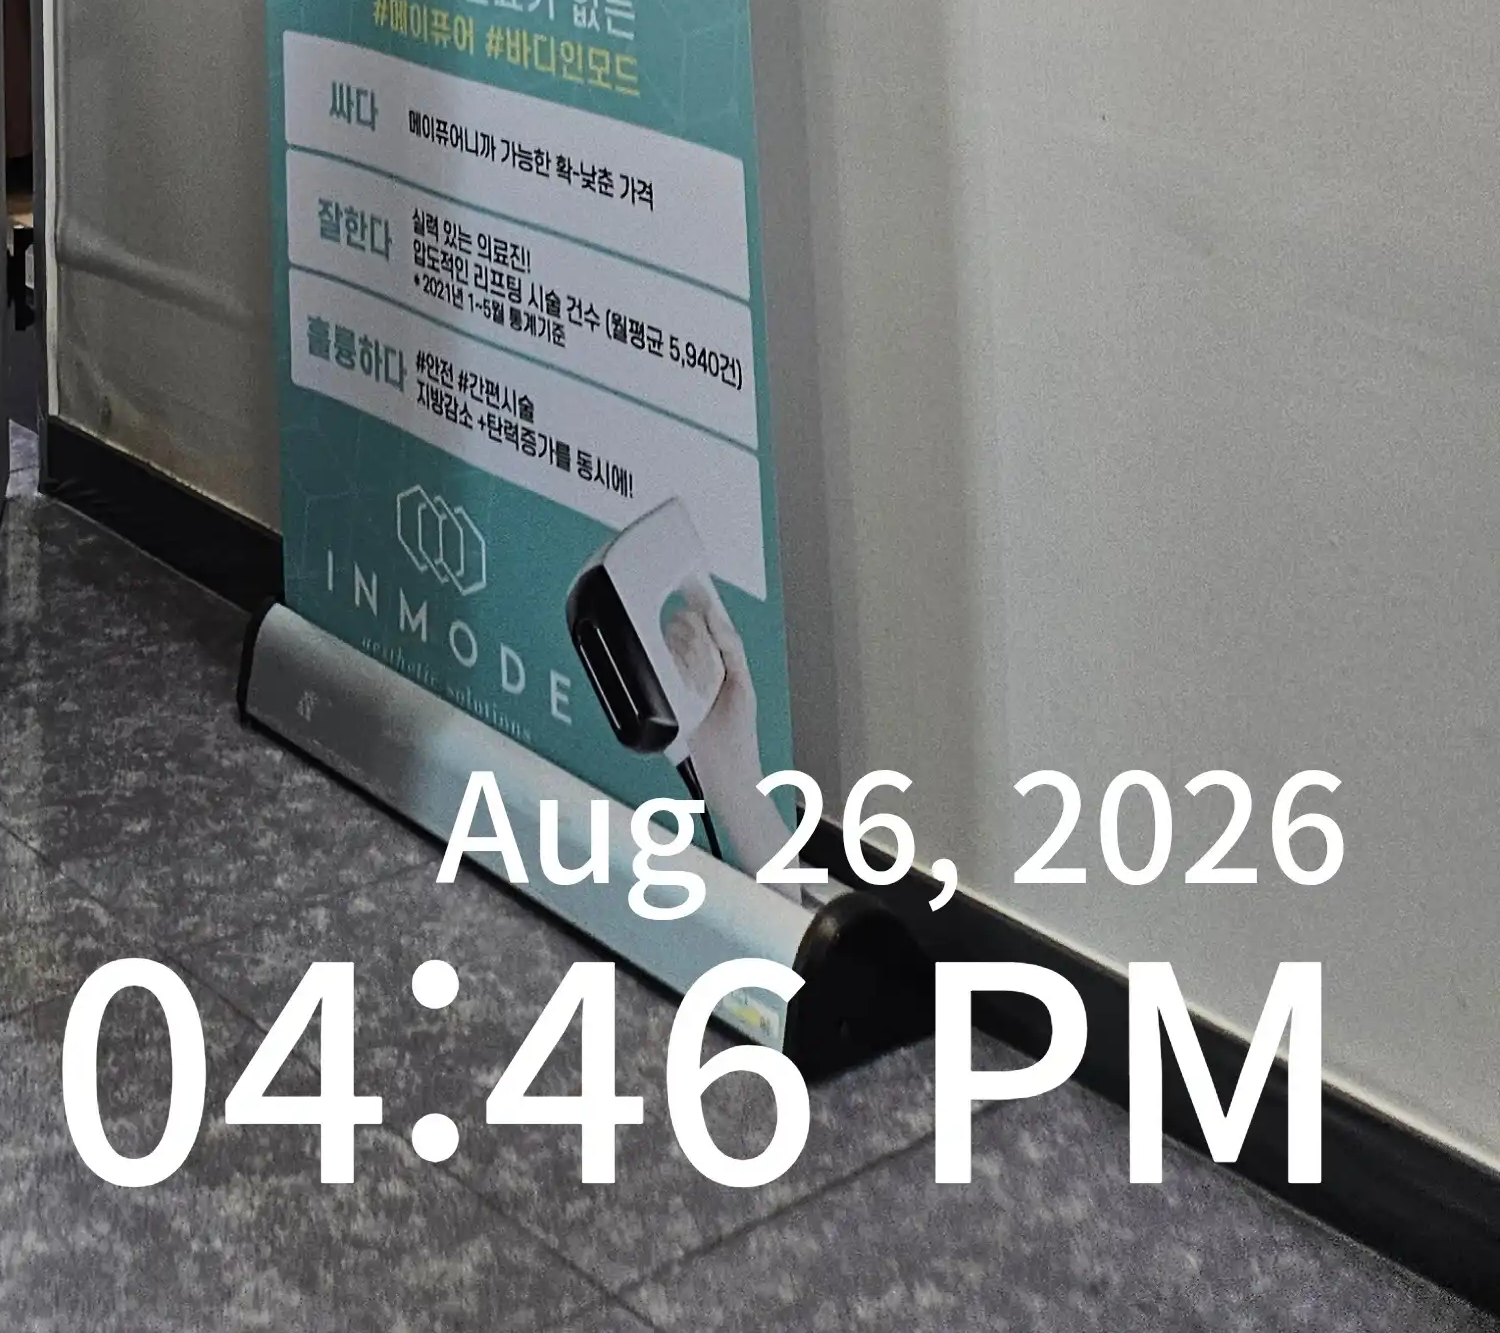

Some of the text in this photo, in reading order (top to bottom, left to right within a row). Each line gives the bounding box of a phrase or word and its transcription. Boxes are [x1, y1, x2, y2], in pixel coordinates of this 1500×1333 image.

[485, 24, 641, 99] #바디인모드
[329, 80, 379, 133] 싸다
[407, 109, 656, 213] 메이퓨어니까 가능한 확-낮춘 가격
[317, 196, 393, 263] 잘한다
[411, 206, 532, 276] 실력 있는 의료진!
[306, 312, 409, 393] 훌륭하다
[412, 238, 744, 393] 압도적인 리프팅 시술 건수 (월평균 5,940건)
[467, 289, 506, 328] 1~5월
[508, 306, 567, 349] 통계기준
[415, 349, 536, 425] #안전 #간편시술
[416, 379, 635, 500] 지방감소 +탄력증가를 동시에!
[326, 548, 573, 727] INMODE
